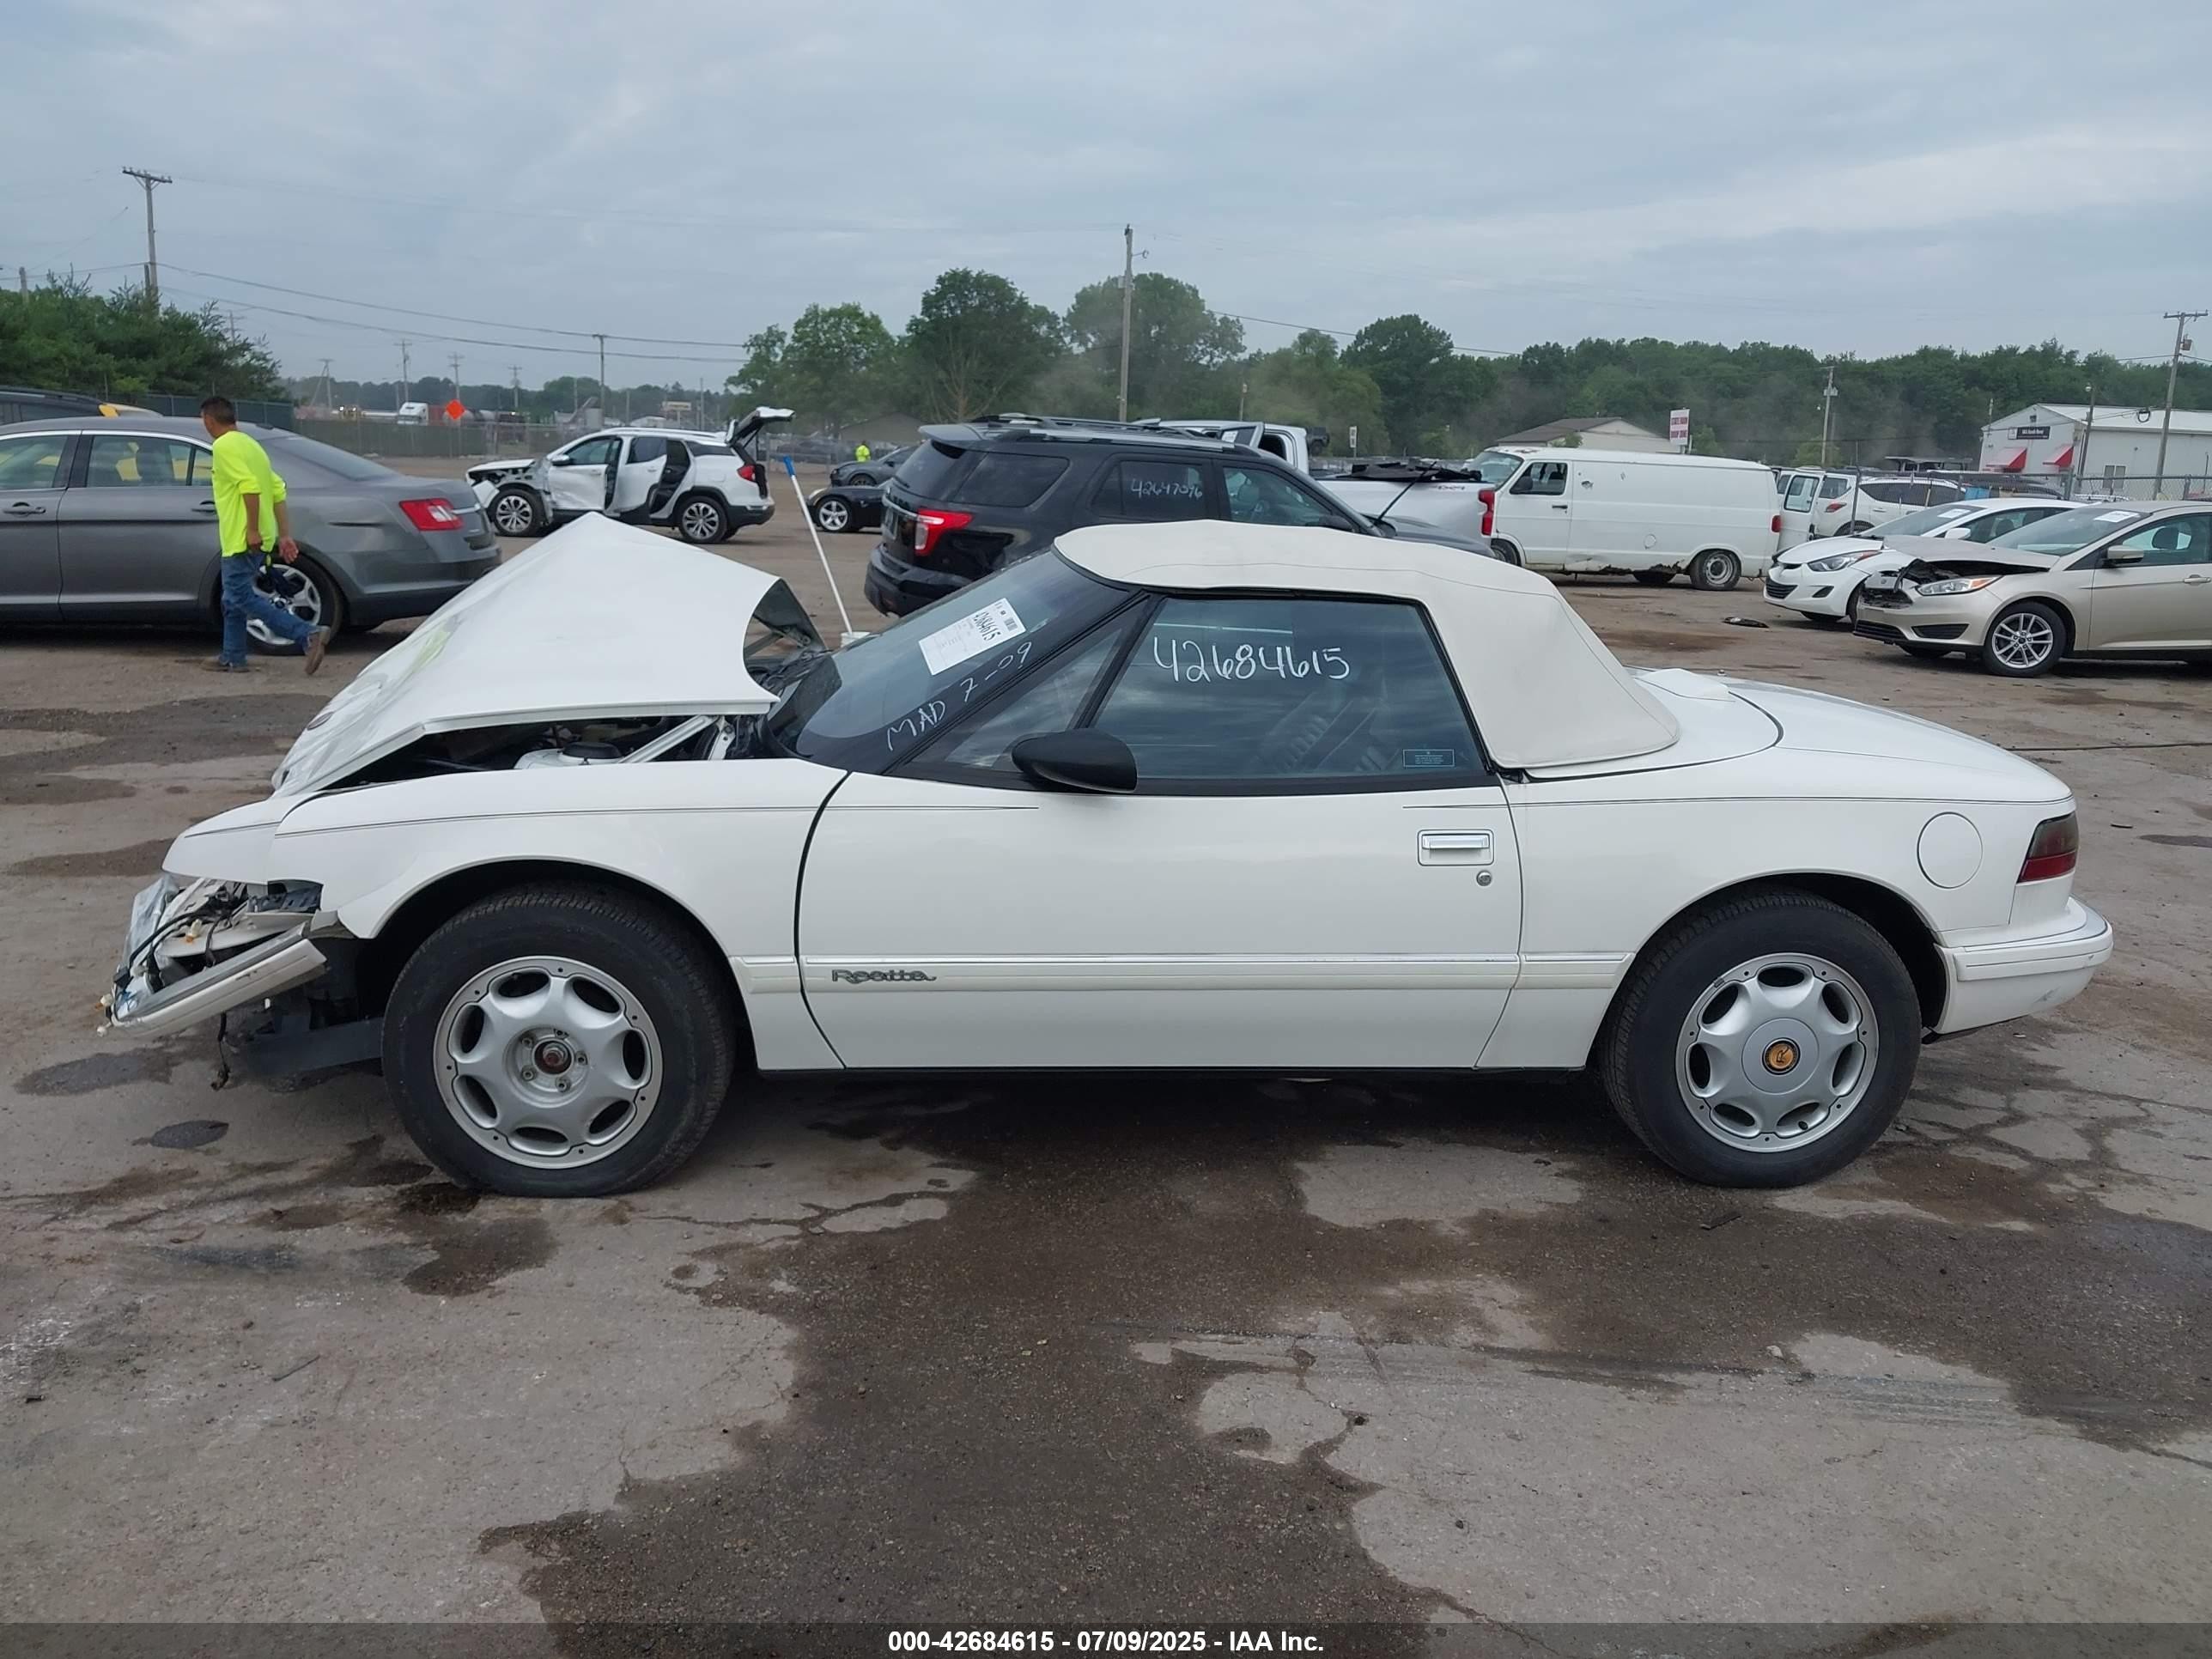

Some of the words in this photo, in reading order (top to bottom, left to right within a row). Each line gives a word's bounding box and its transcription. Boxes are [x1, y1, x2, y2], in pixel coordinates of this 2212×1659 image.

[1153, 636, 1351, 683] 42684615
[886, 700, 946, 752] MAD
[831, 969, 938, 985] Reatta
